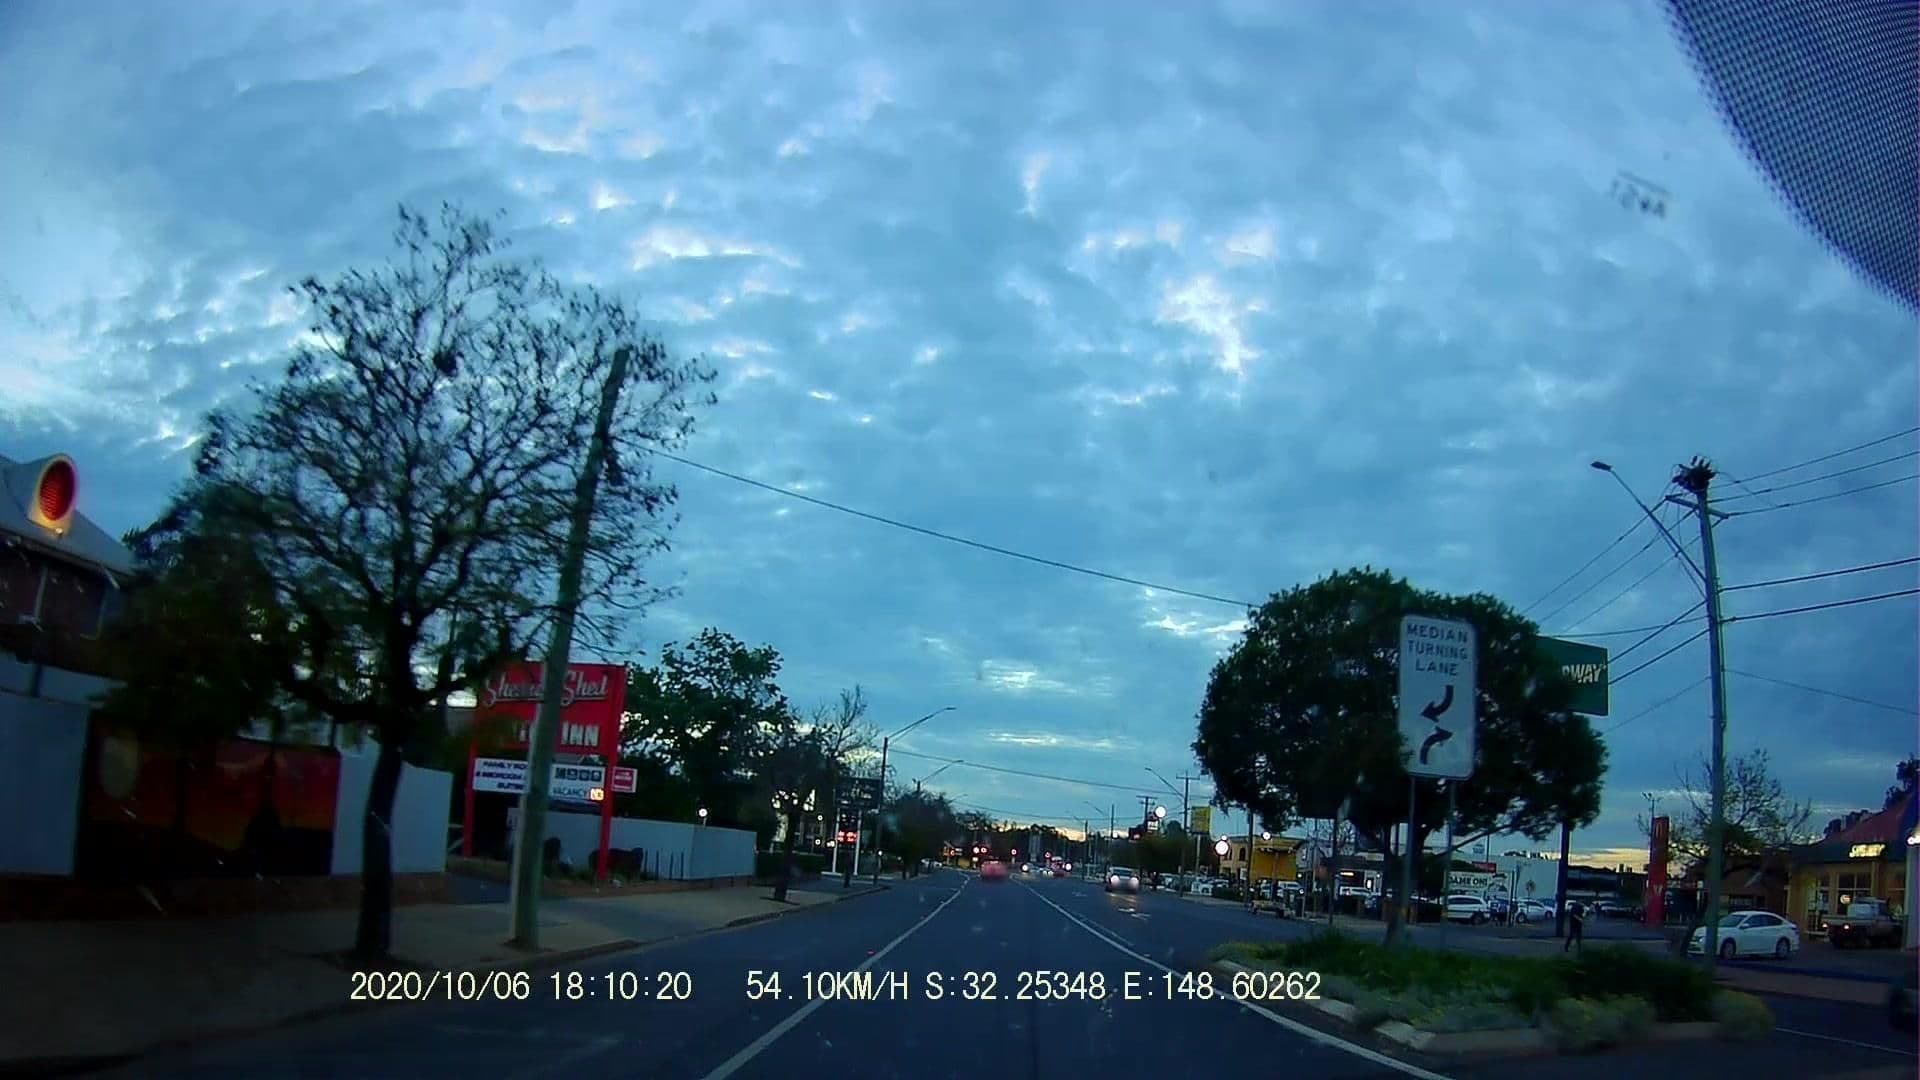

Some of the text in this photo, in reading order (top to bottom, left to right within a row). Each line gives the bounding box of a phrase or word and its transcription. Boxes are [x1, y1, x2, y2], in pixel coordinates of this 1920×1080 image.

[1407, 623, 1468, 643] MEDIAN
[1407, 639, 1468, 660] TURNING
[1415, 658, 1457, 676] LANE
[560, 669, 609, 707] Shed
[561, 721, 600, 747] INN
